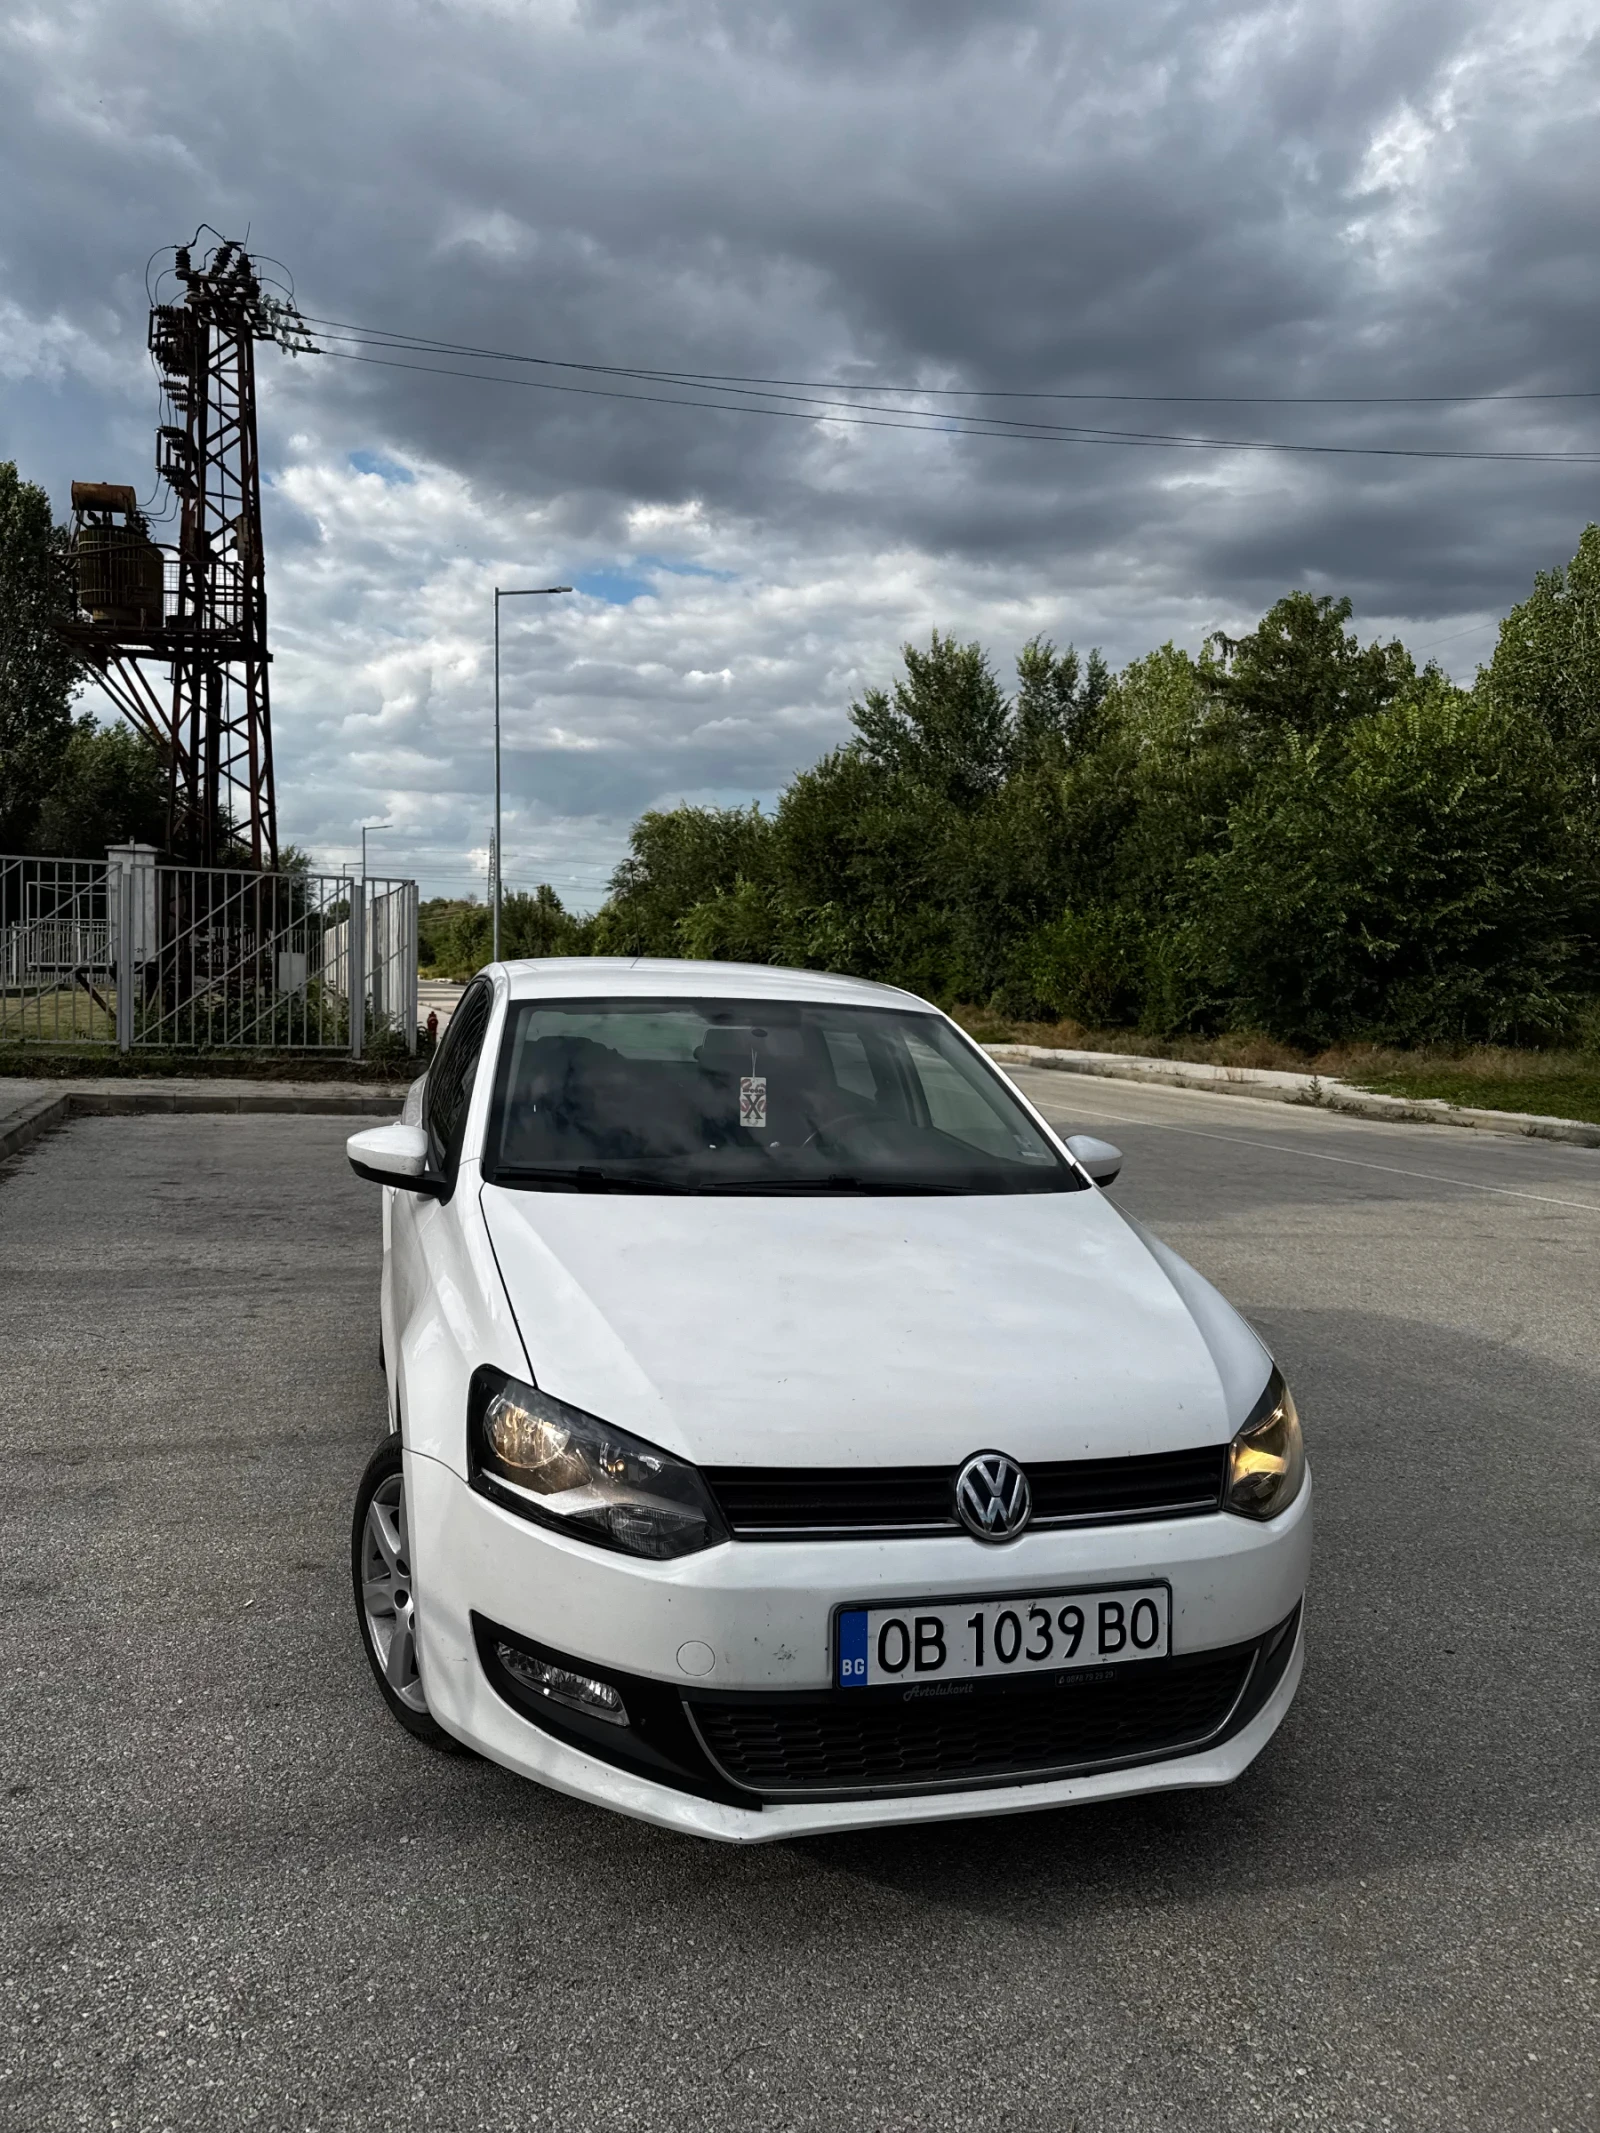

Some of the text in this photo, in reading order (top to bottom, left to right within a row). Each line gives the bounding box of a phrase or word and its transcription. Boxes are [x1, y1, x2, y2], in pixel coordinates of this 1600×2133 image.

[742, 1093, 765, 1119] X
[957, 1454, 1030, 1540] VW
[877, 1597, 1160, 1674] OB 1039 BO
[841, 1658, 865, 1676] BG
